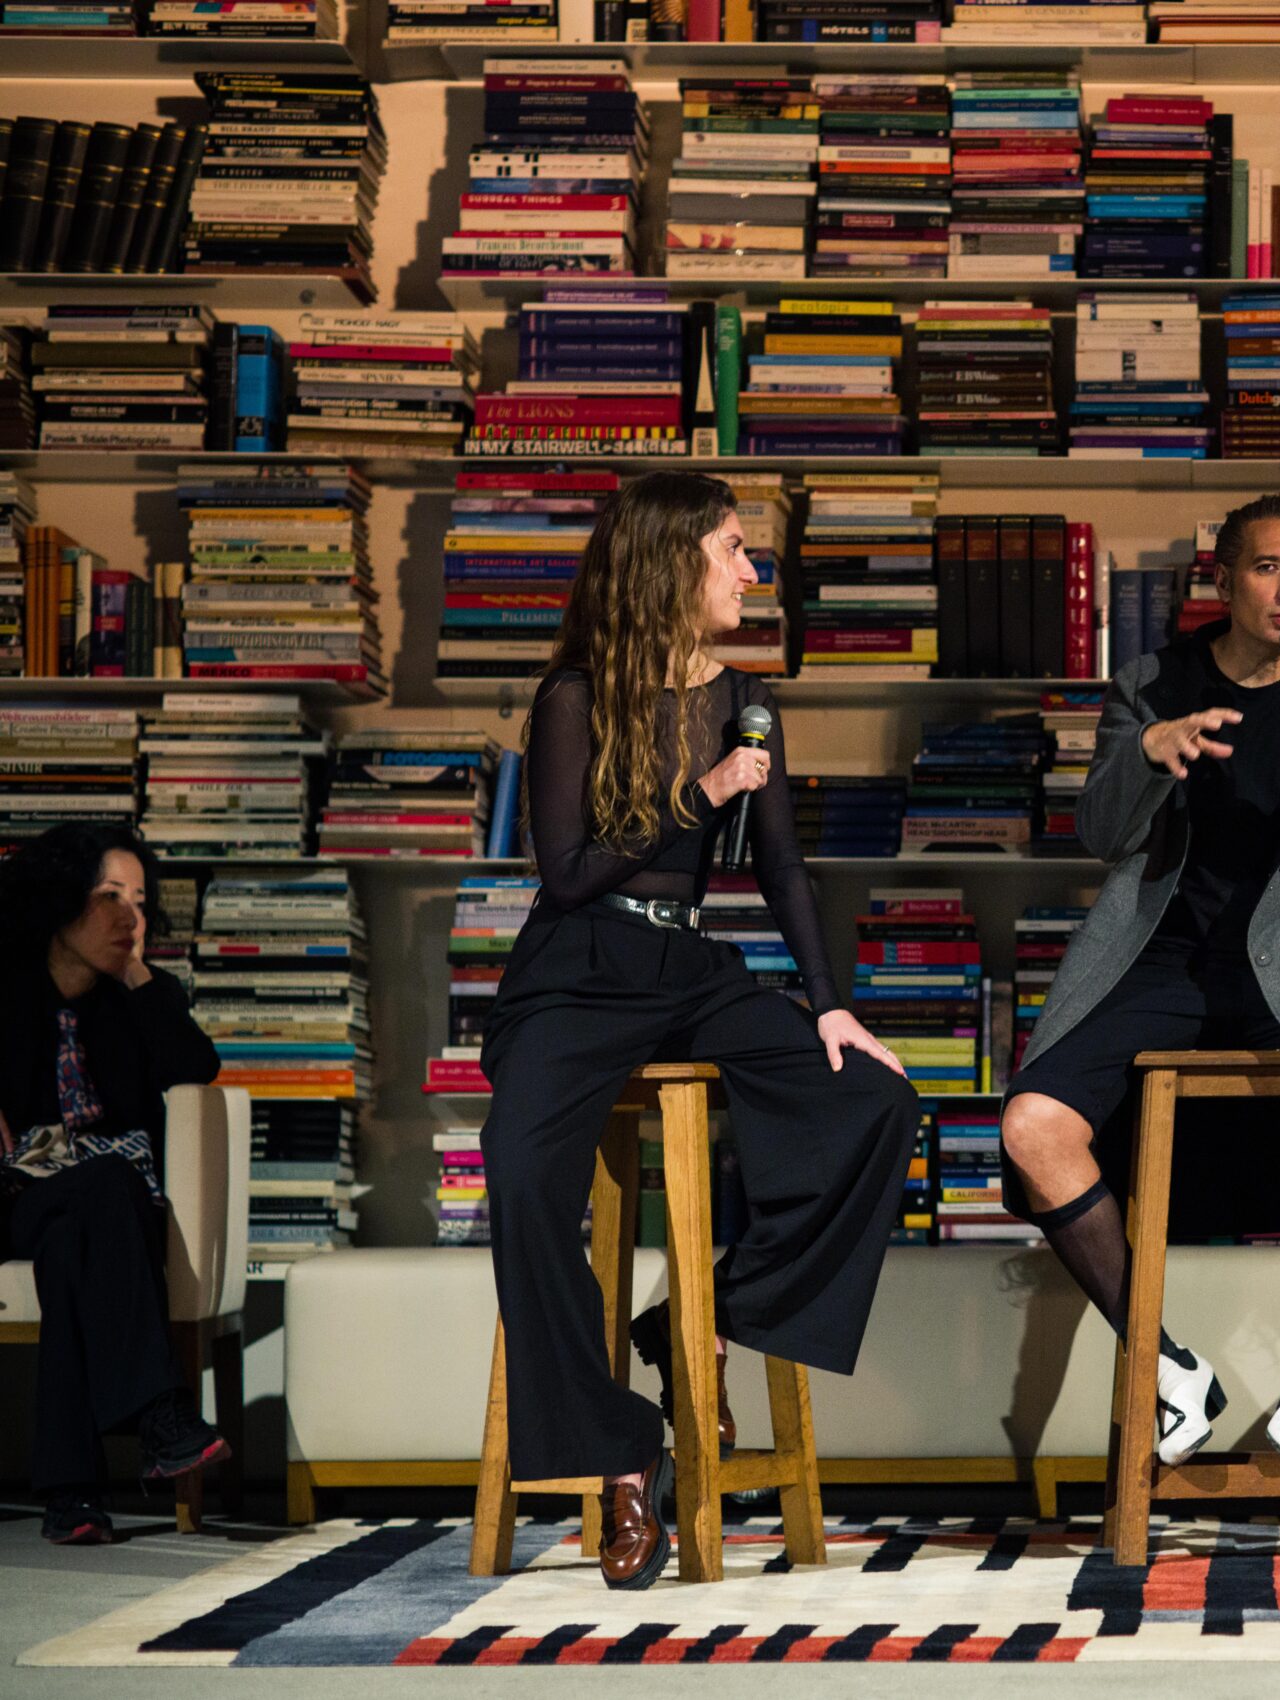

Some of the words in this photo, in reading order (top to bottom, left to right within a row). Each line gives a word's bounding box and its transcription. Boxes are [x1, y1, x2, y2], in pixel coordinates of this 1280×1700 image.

[873, 25, 886, 35] DE
[242, 126, 277, 134] BRANDT
[468, 195, 517, 204] SURREAL
[522, 195, 562, 204] THINGS
[482, 440, 507, 455] MY
[513, 440, 604, 455] STAIRWELL
